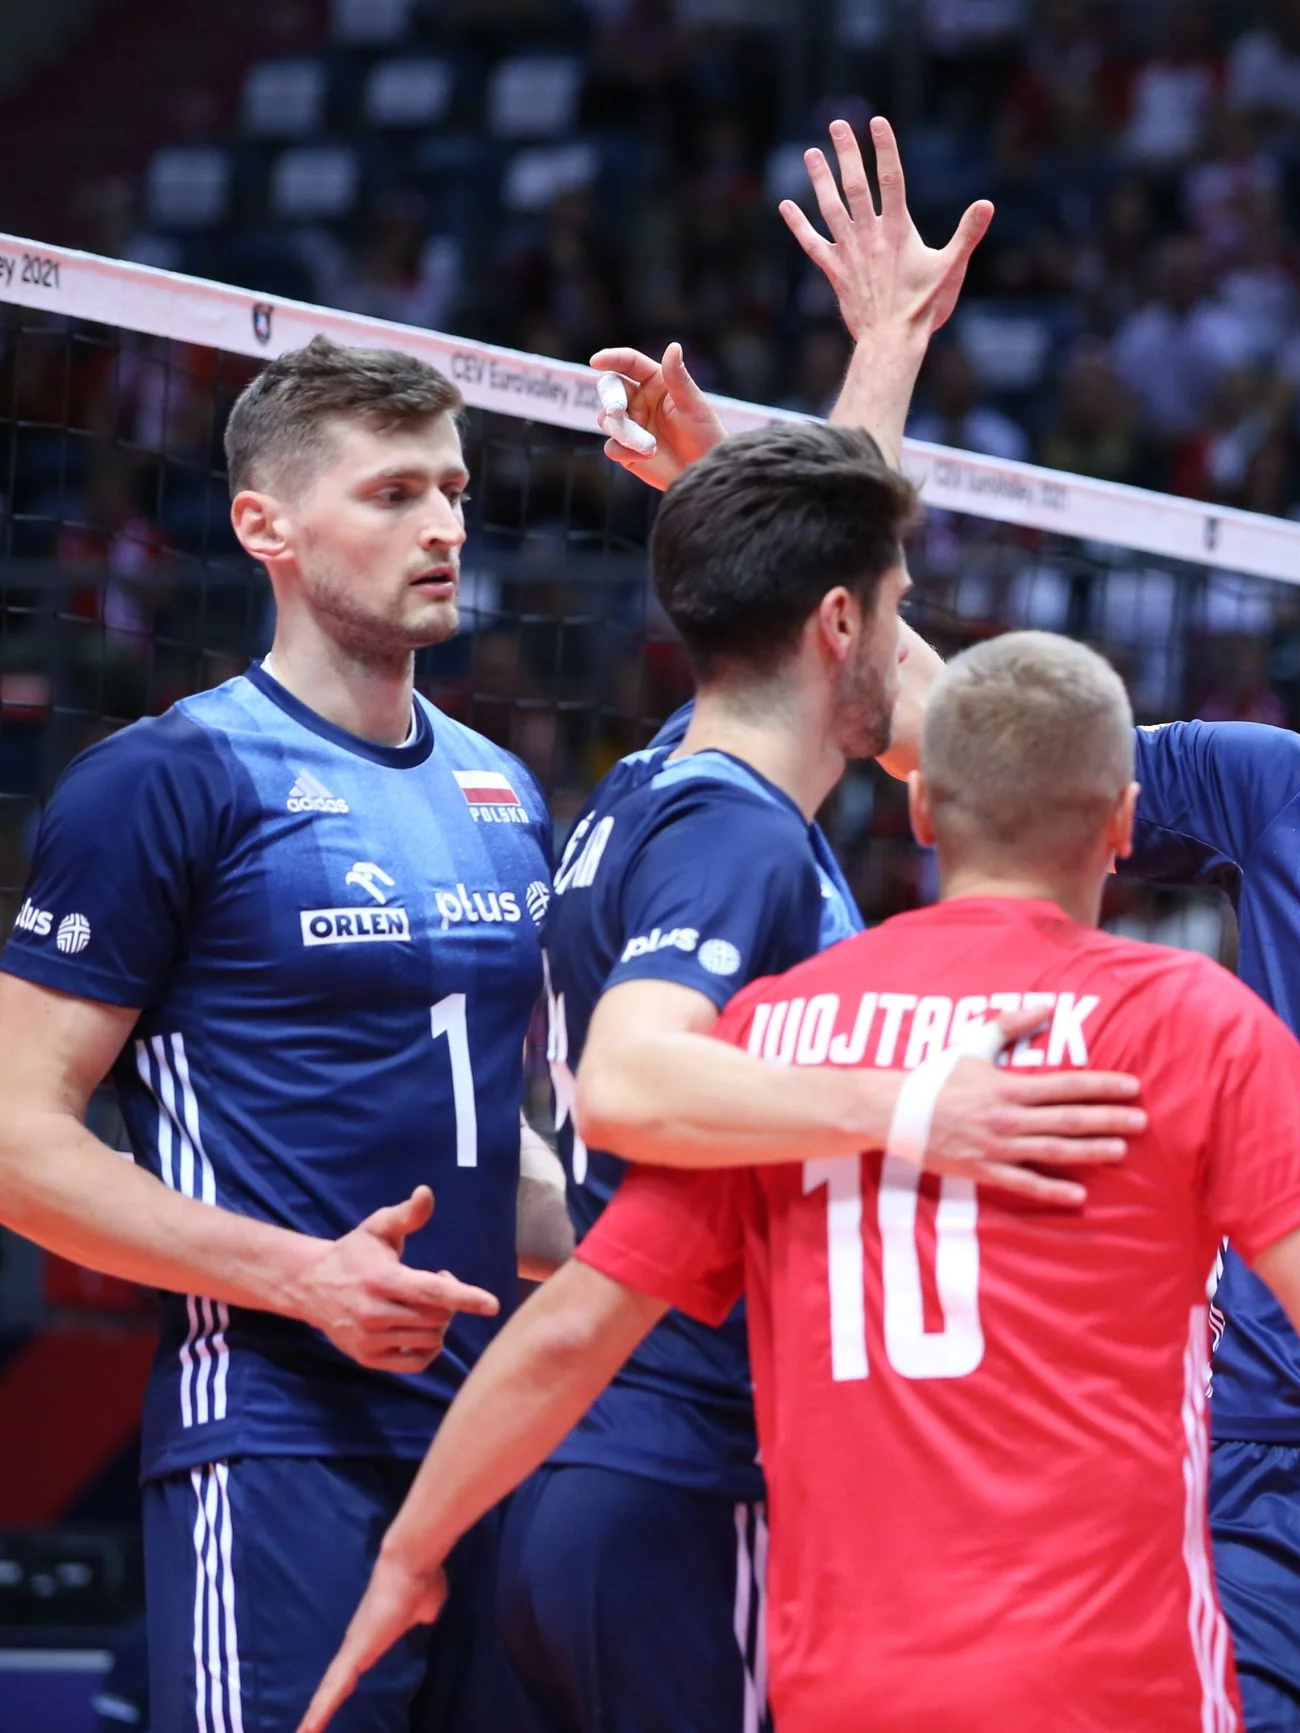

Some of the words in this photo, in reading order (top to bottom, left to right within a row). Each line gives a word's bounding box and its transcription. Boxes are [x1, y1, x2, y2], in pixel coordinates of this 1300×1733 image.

[22, 253, 60, 288] 2021
[451, 352, 484, 385] CEV
[287, 797, 349, 813] adidas
[469, 806, 529, 824] POLSKA
[310, 908, 405, 938] ORLEN
[435, 883, 521, 930] plus
[621, 927, 699, 963] plus
[430, 993, 477, 1167] 1
[803, 1151, 985, 1382] 10
